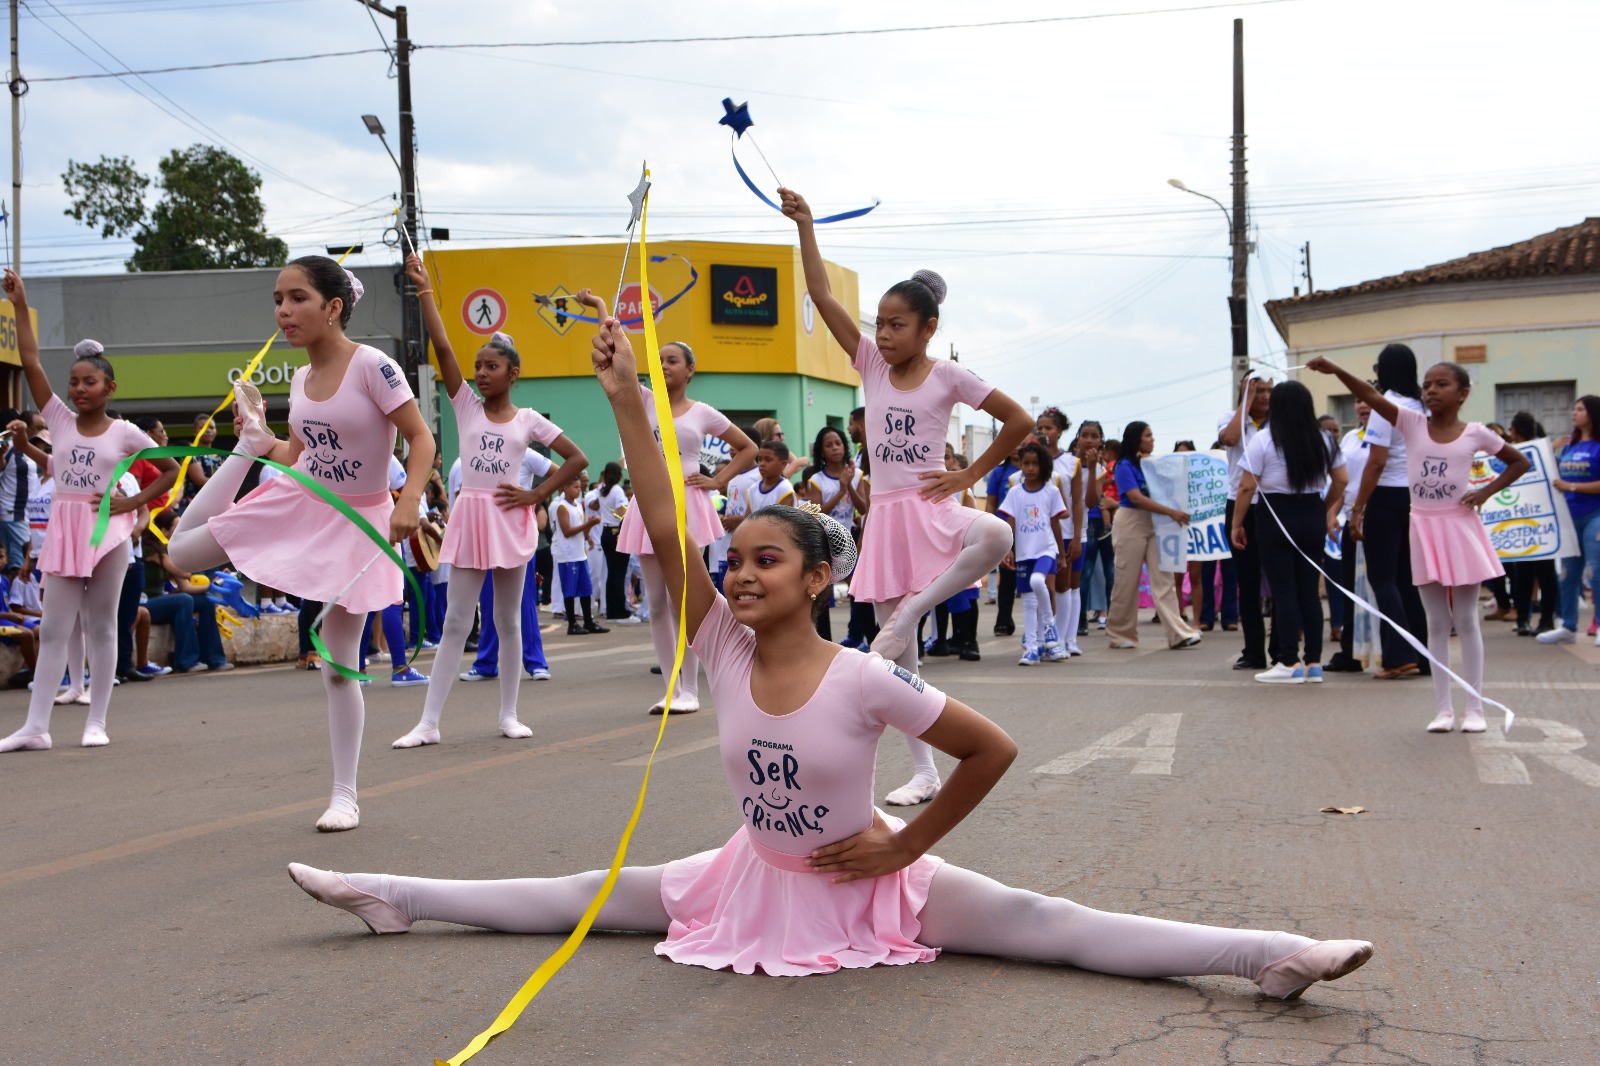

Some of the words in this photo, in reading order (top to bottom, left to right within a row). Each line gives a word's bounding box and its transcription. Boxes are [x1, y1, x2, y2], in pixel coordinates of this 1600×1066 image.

[303, 419, 331, 428] PROGRAMA
[751, 738, 794, 752] PROGRAMA
[748, 749, 801, 790] SeR
